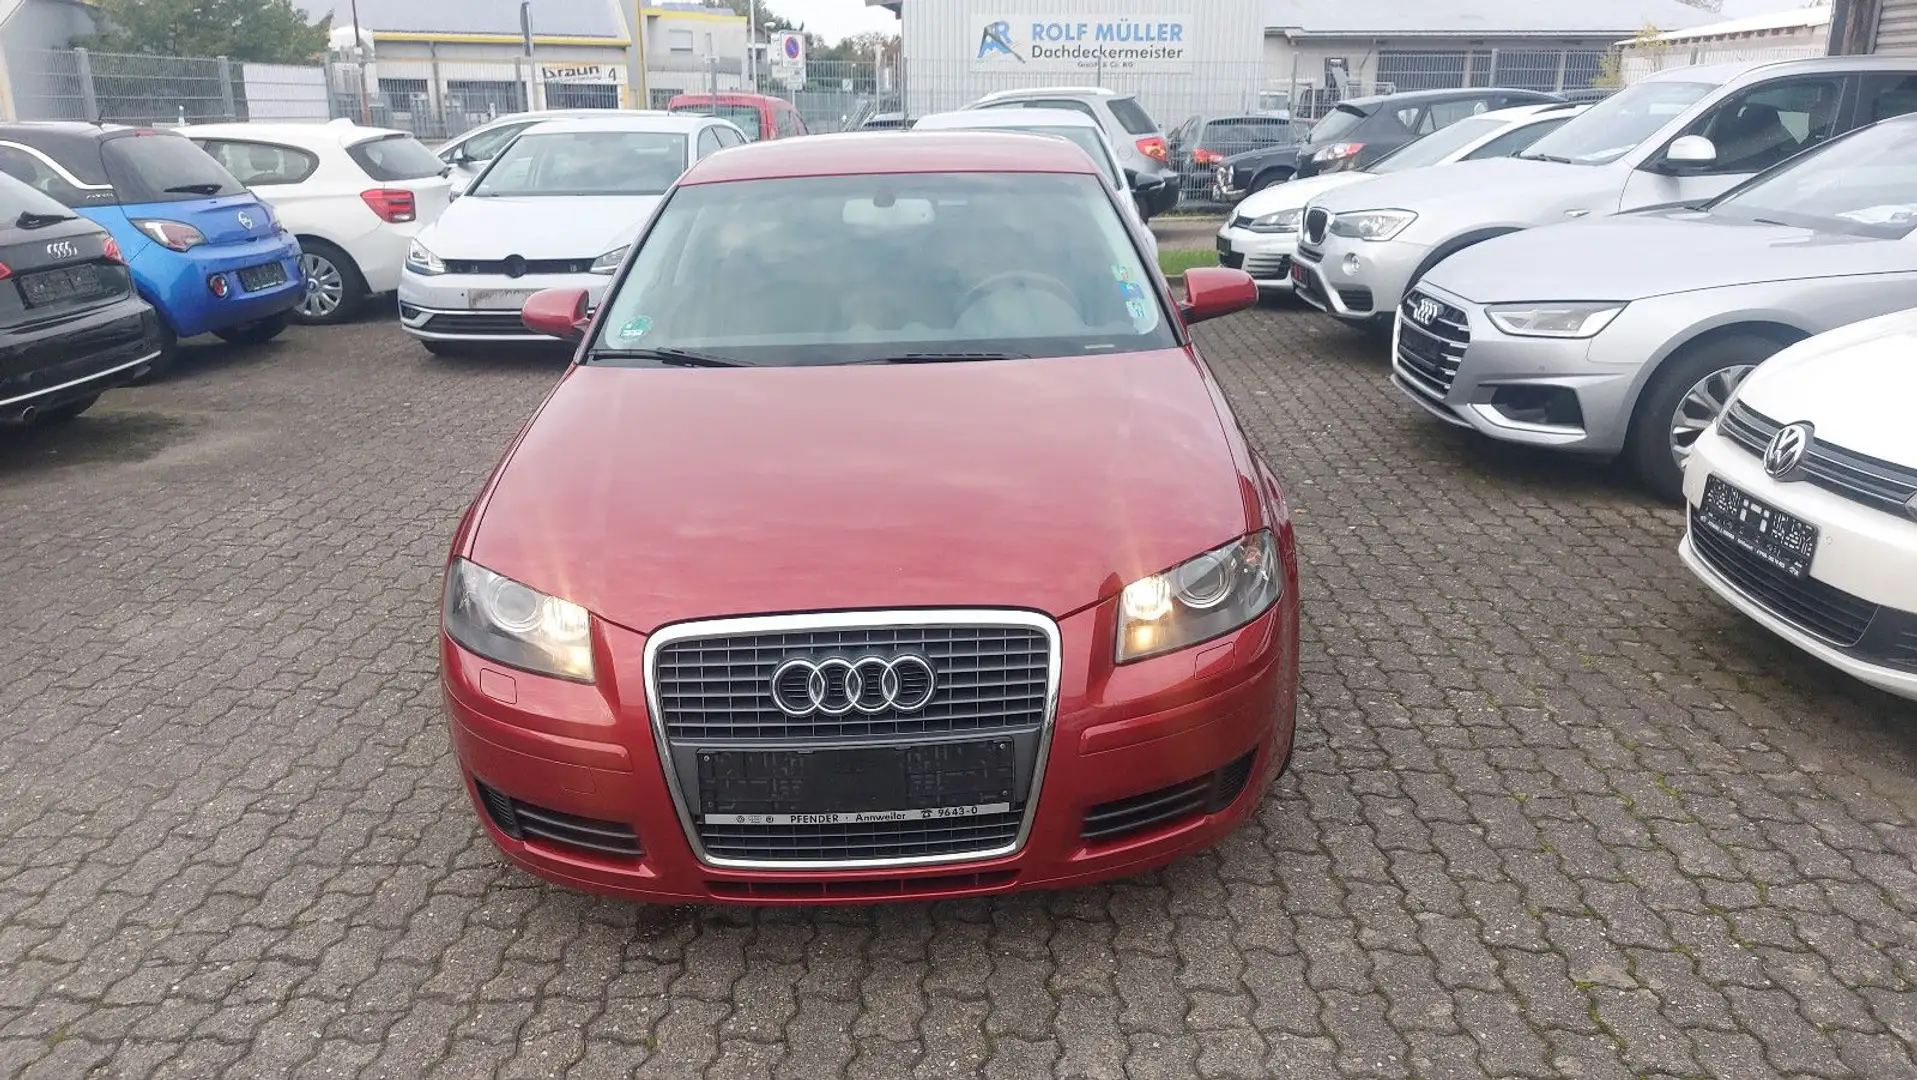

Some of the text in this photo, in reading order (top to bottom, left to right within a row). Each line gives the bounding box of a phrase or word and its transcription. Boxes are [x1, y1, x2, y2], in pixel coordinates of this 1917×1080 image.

[1032, 18, 1183, 41] ROLF MÜLLER
[1032, 44, 1183, 58] Dachdeckermeister
[790, 805, 978, 824] PFENDER Annweiler 9643-0
